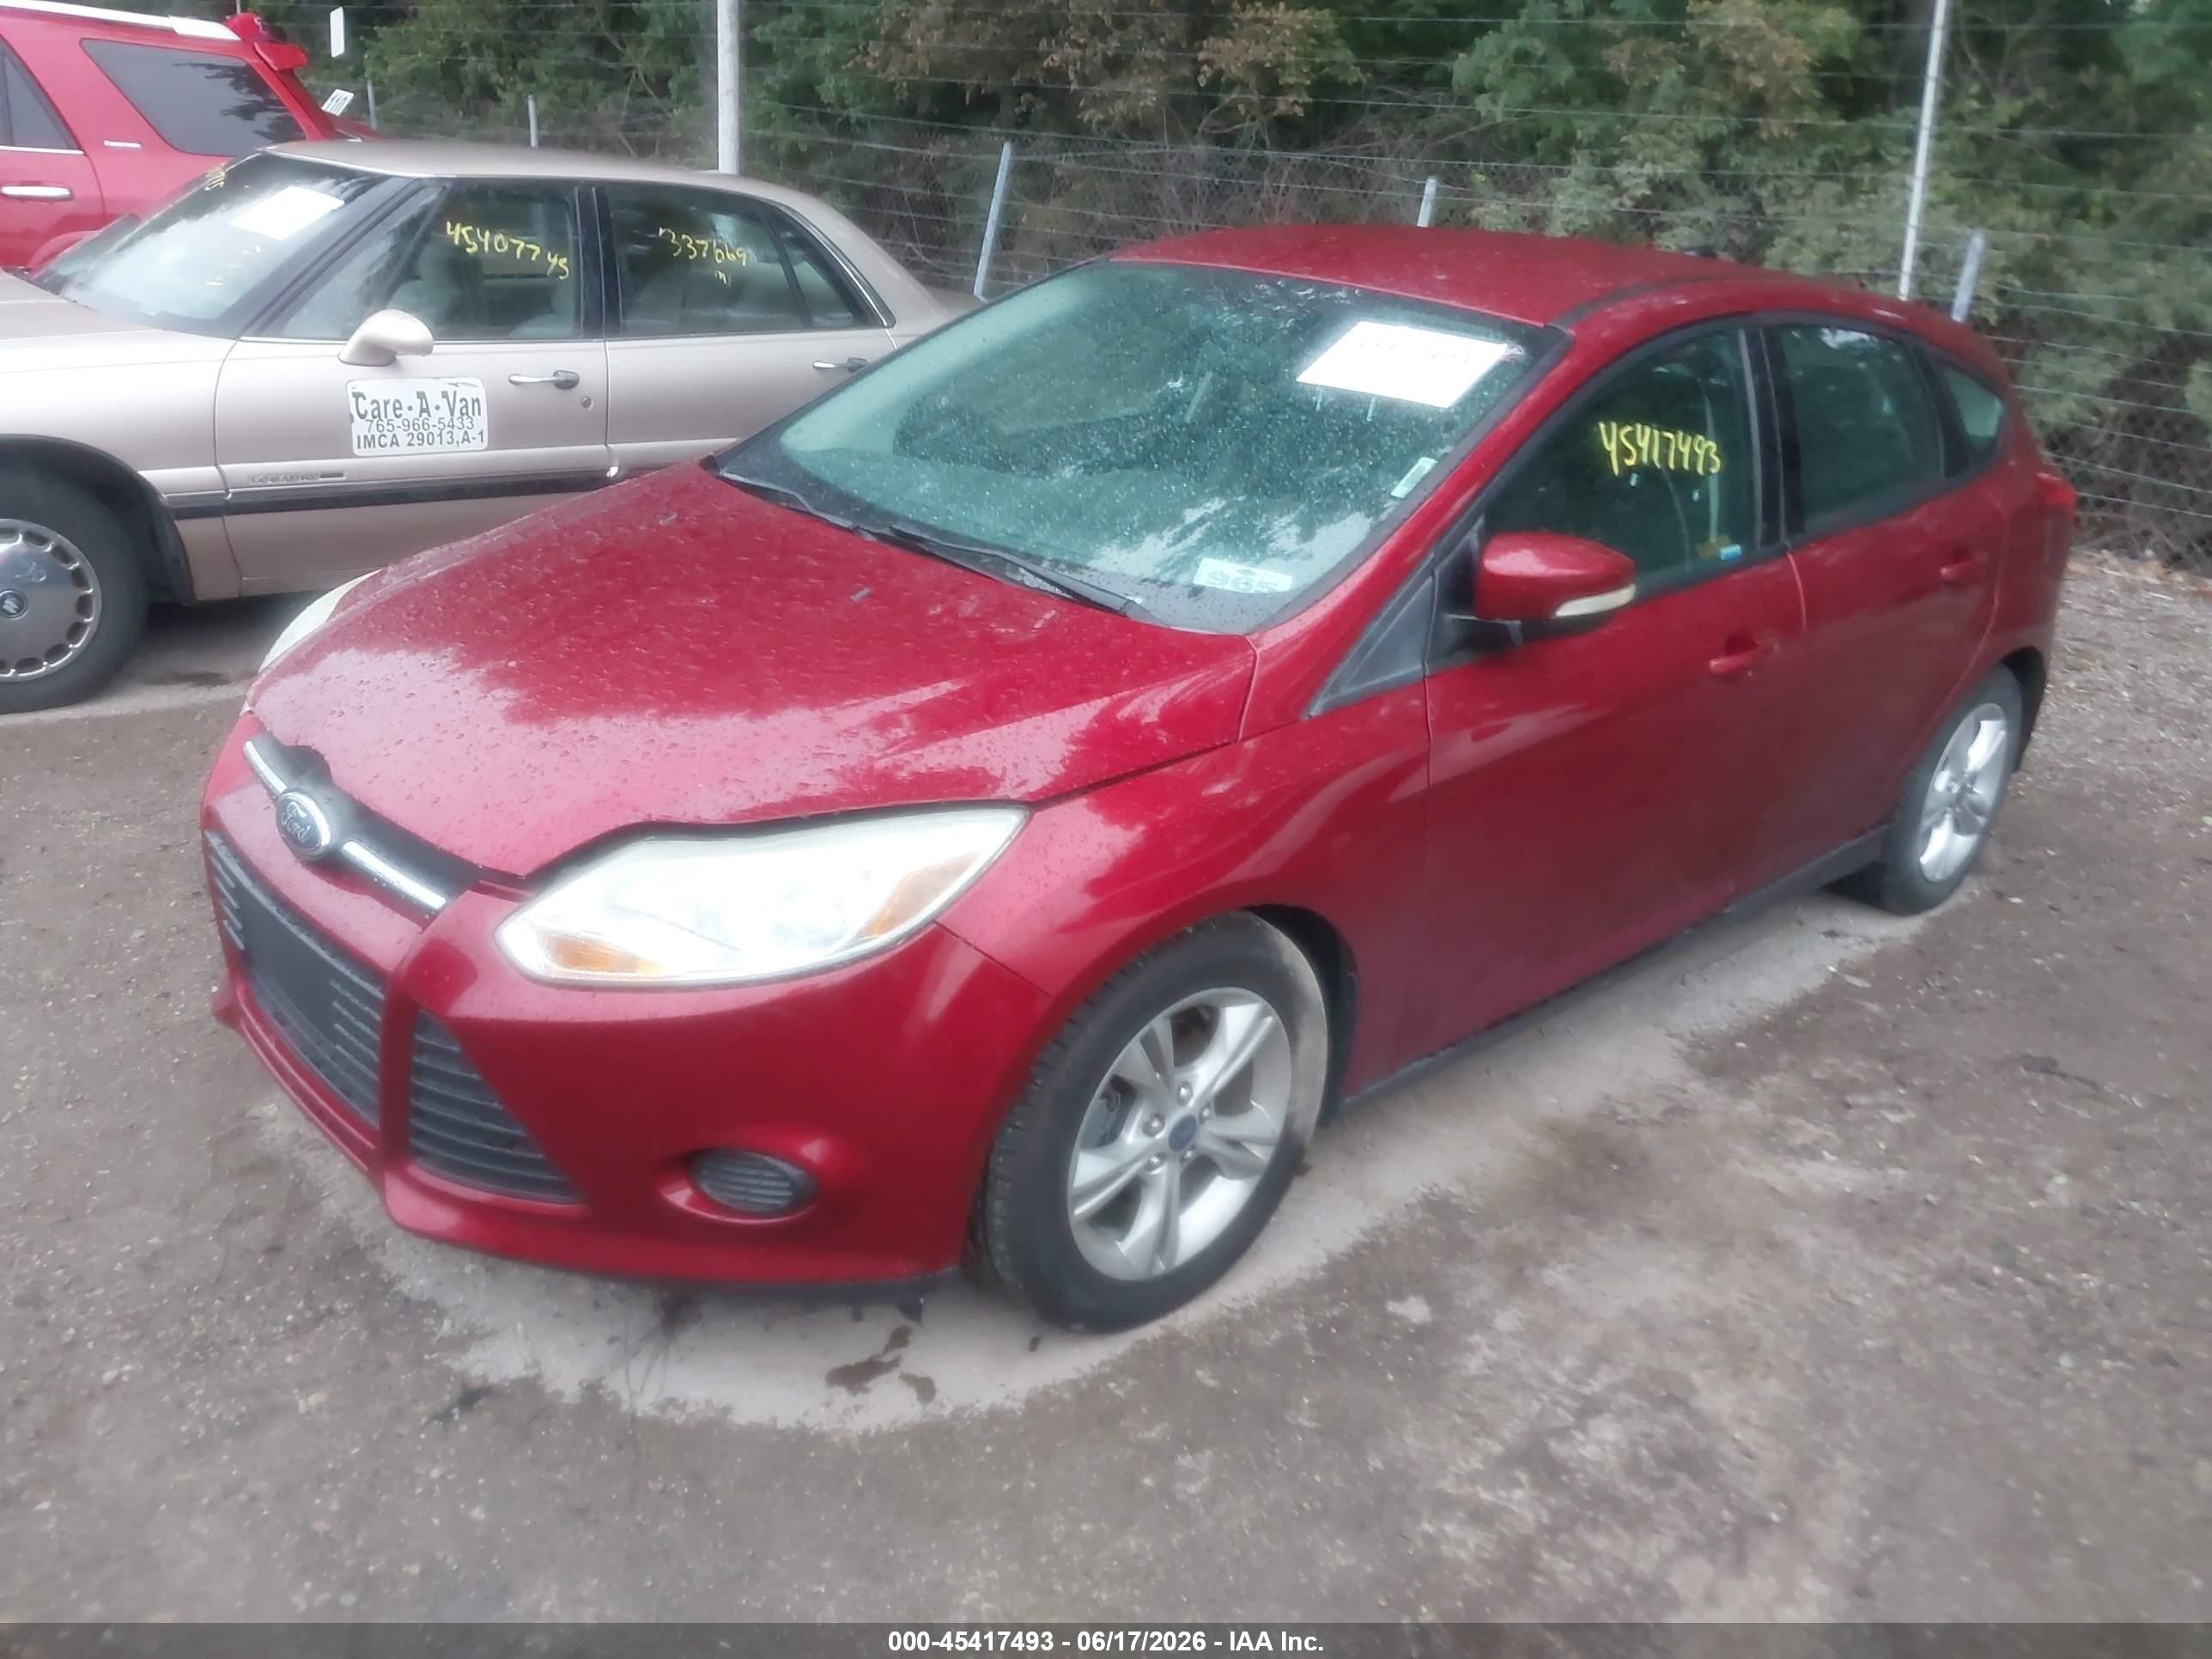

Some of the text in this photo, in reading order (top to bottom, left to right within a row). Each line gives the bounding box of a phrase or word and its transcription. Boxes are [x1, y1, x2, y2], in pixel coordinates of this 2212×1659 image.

[366, 416, 474, 433] 765-966-5433
[356, 434, 400, 449] IMCA
[1598, 420, 1722, 476] 45417493
